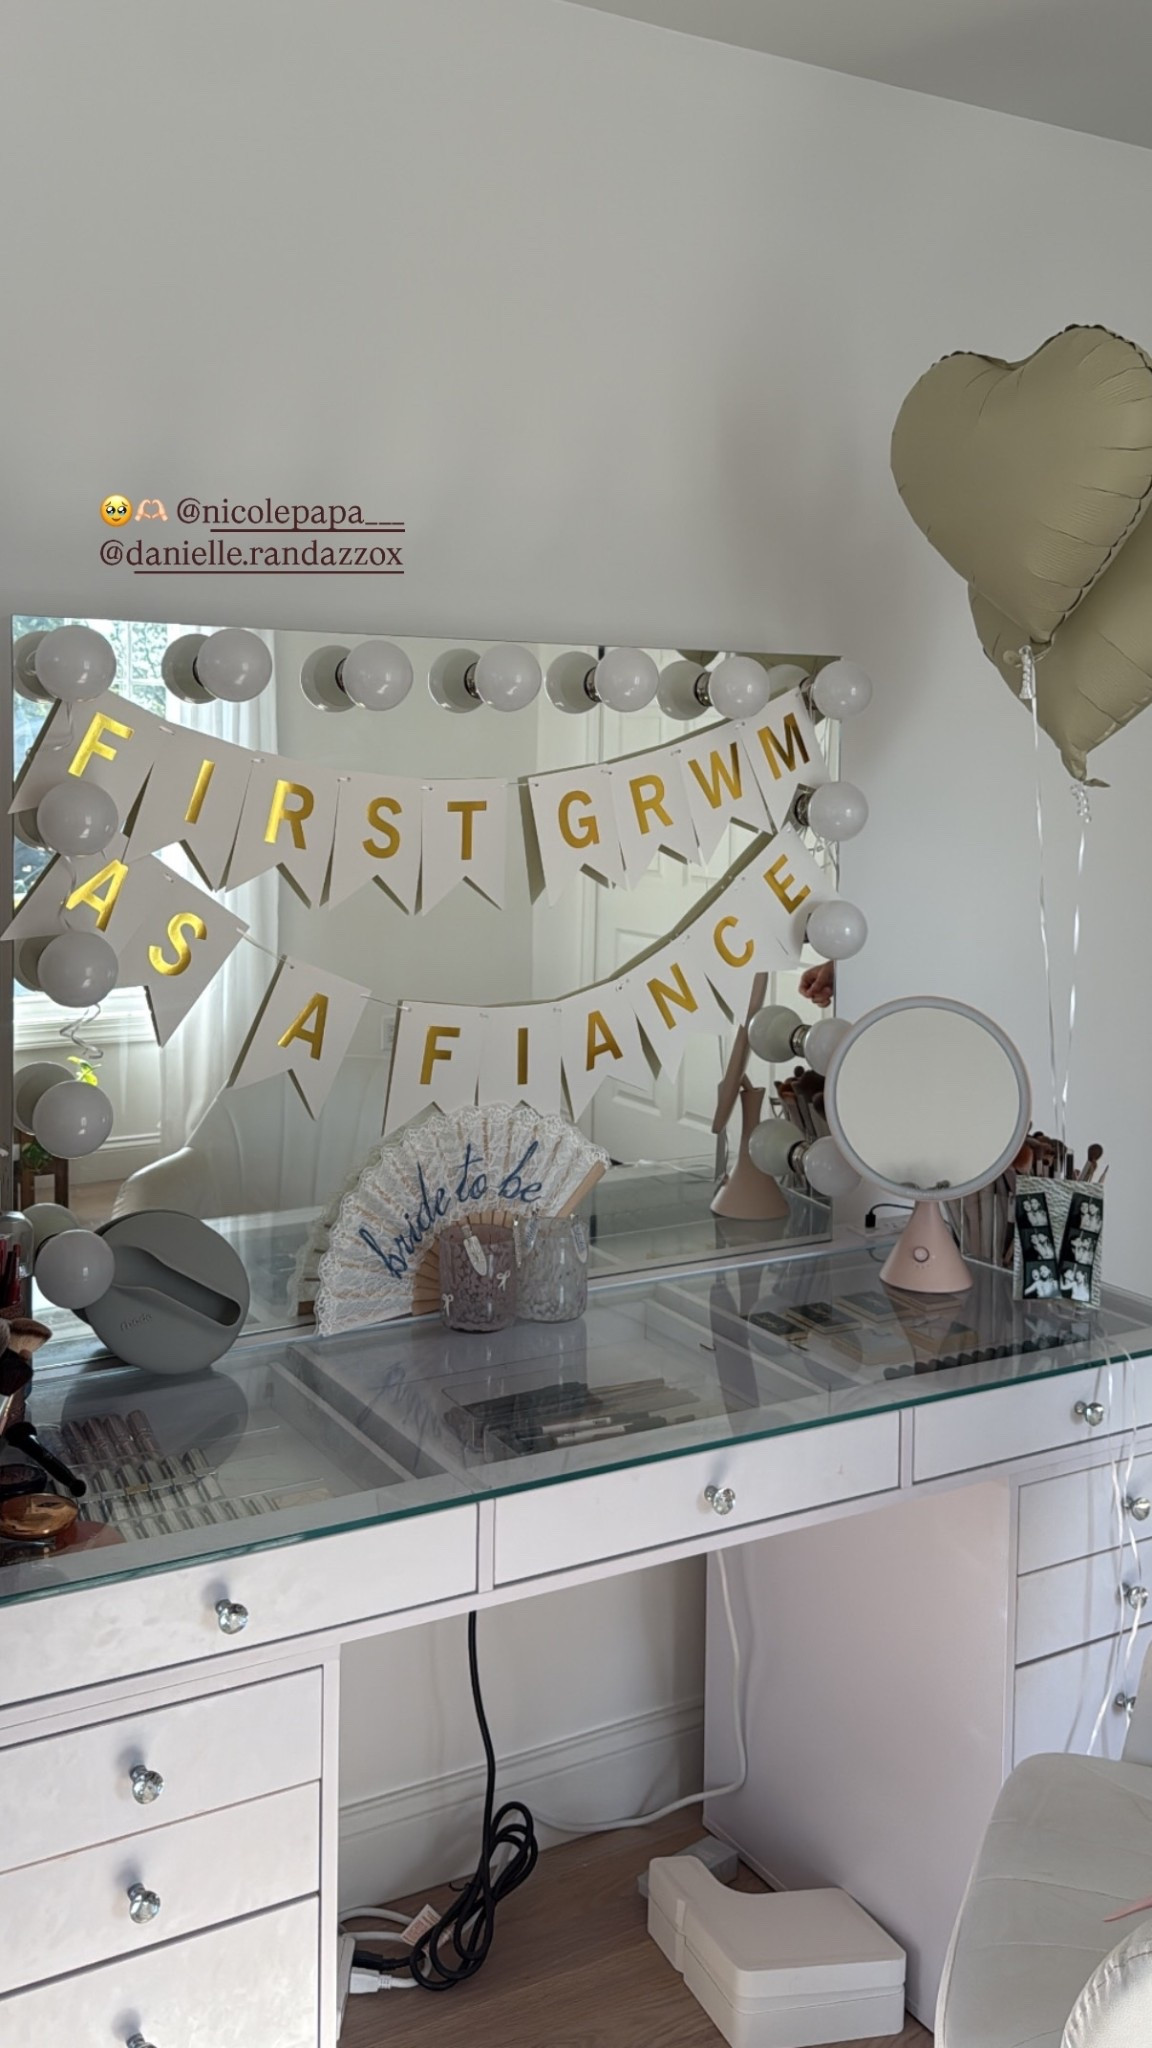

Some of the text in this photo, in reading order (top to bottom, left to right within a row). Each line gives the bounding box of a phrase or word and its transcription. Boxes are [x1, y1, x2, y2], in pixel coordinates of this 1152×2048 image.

[67, 711, 811, 861] FIRST GRWM
[64, 853, 812, 1086] AS A FIANCE
[358, 1160, 451, 1280] bride
[455, 1143, 488, 1203] to
[497, 1140, 543, 1203] be
